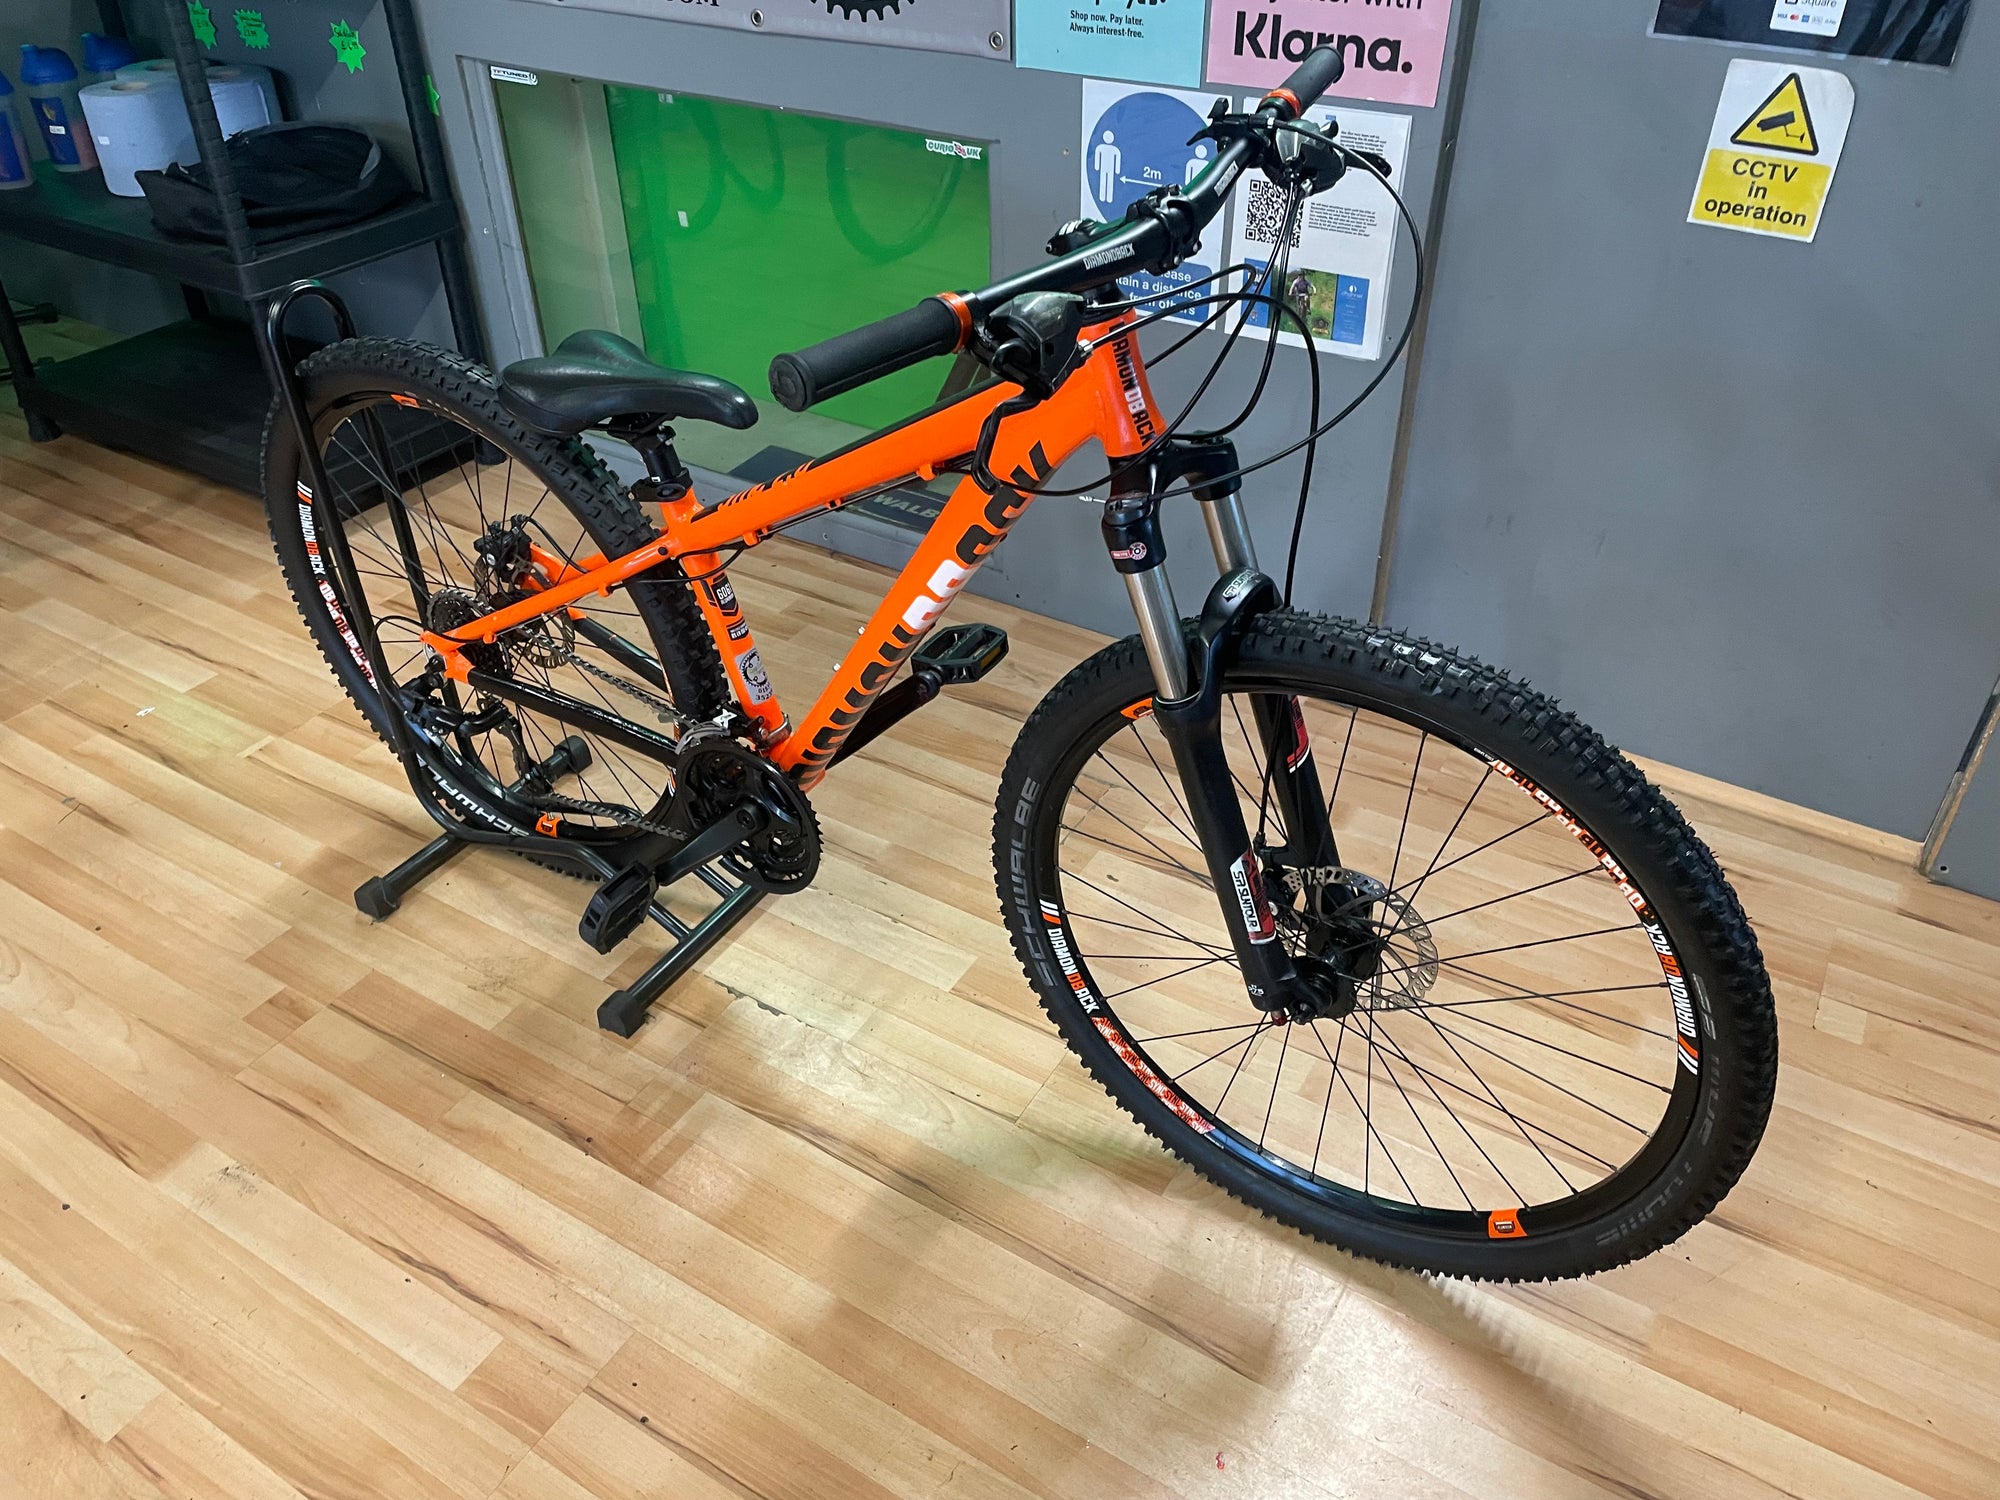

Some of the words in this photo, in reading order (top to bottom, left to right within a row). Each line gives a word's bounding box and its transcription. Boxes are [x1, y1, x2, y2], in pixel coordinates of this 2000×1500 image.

[1070, 10, 1088, 21] Shop
[1091, 14, 1107, 23] now.
[1110, 13, 1123, 25] Pay
[1125, 15, 1144, 26] later.
[1070, 22, 1094, 35] Always
[1096, 25, 1144, 38] interest-free.
[928, 141, 954, 154] CURIO
[966, 147, 979, 157] UK
[1143, 166, 1162, 180] 2m
[1732, 158, 1799, 183] CCTV
[1747, 181, 1768, 200] in
[1704, 198, 1807, 227] operation
[1083, 243, 1135, 271] DIAMONDBACK
[1160, 269, 1192, 282] ease
[1142, 281, 1149, 290] a
[1152, 281, 1202, 300] distnce
[873, 493, 941, 518] WALB
[298, 503, 326, 575] DIAMONDBACK
[416, 752, 530, 837] SCHWAL
[1010, 776, 1058, 988] SCHWALBE
[1239, 887, 1259, 929] SUNTOUR
[1047, 927, 1100, 1015] DIAMONDBACK
[1642, 921, 1697, 1038] DIAMONDBACK
[1123, 1050, 1139, 1067] SYNC
[1149, 1080, 1166, 1097] SYNC
[1164, 1090, 1180, 1106] SYNC
